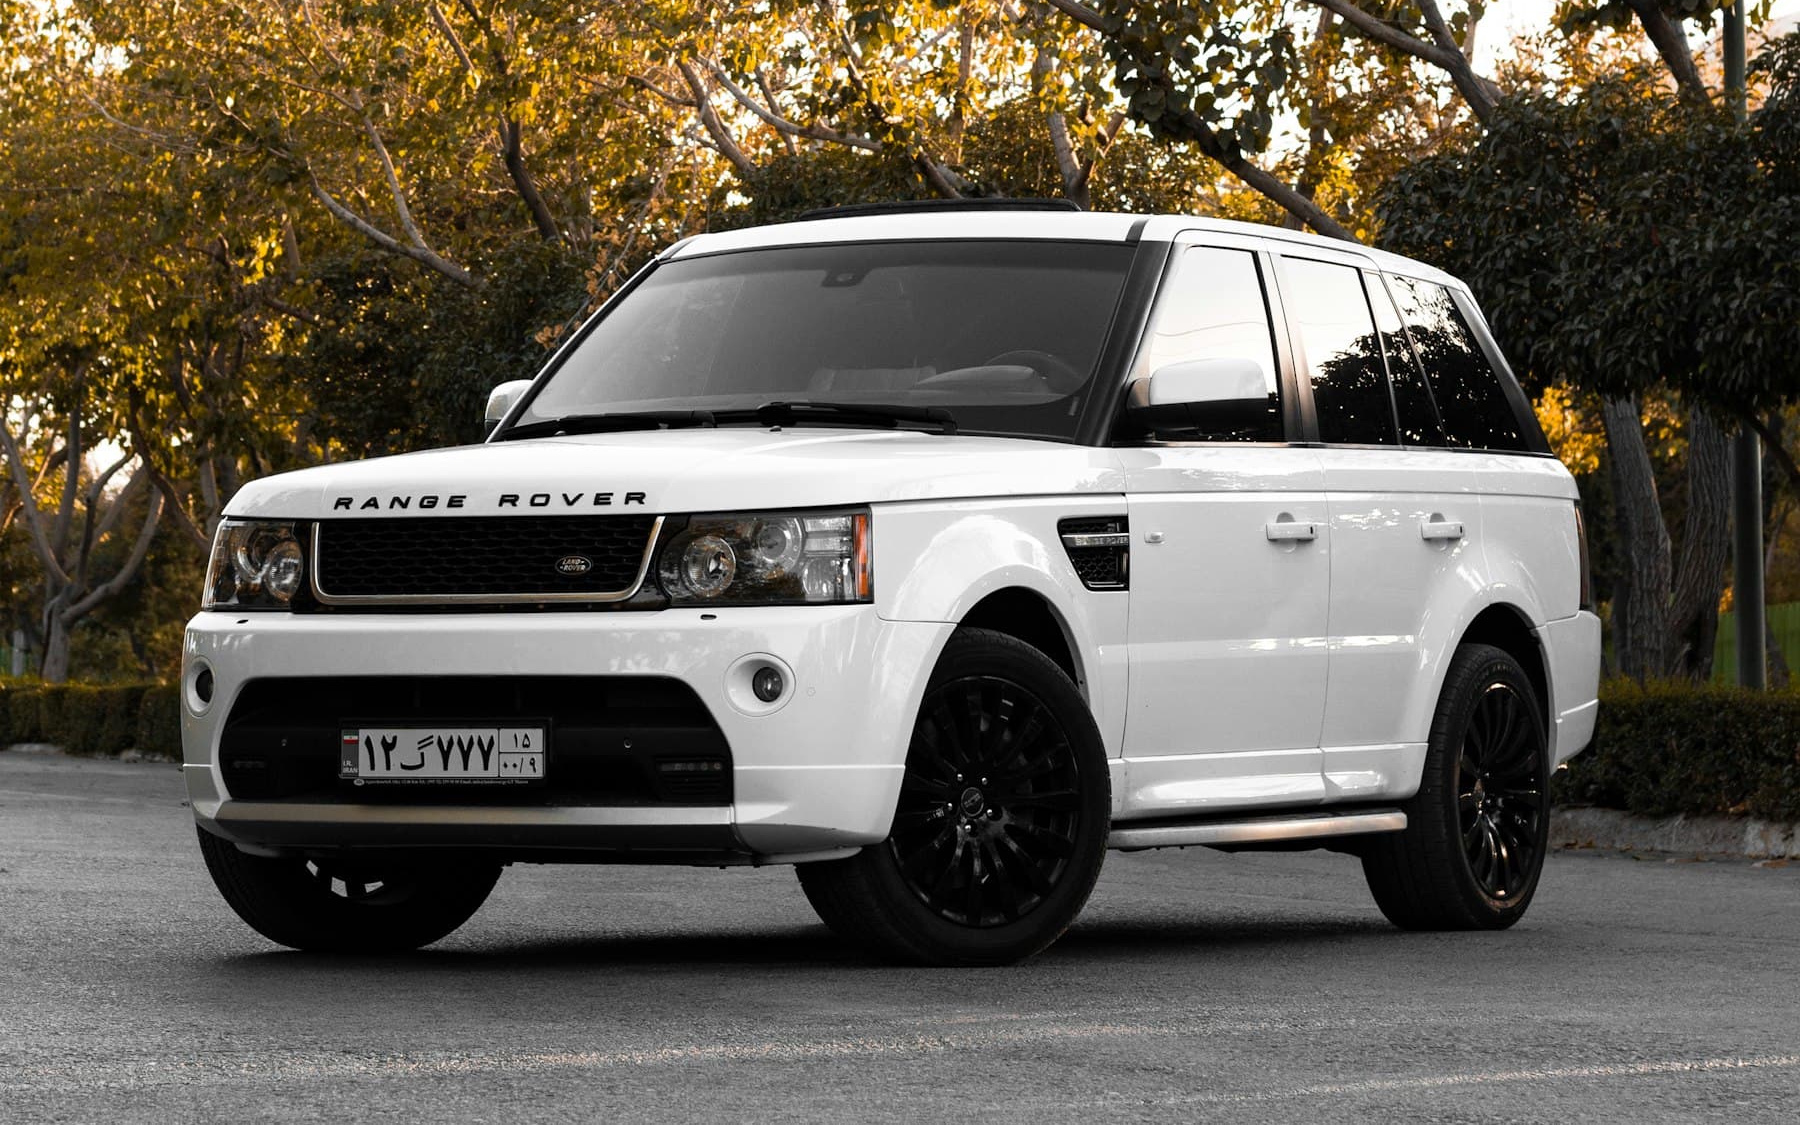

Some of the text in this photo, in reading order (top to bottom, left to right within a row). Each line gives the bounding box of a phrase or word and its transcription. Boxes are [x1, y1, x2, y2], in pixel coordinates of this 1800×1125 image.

[333, 491, 647, 511] RANGE ROVER
[513, 733, 531, 749] ۱۵
